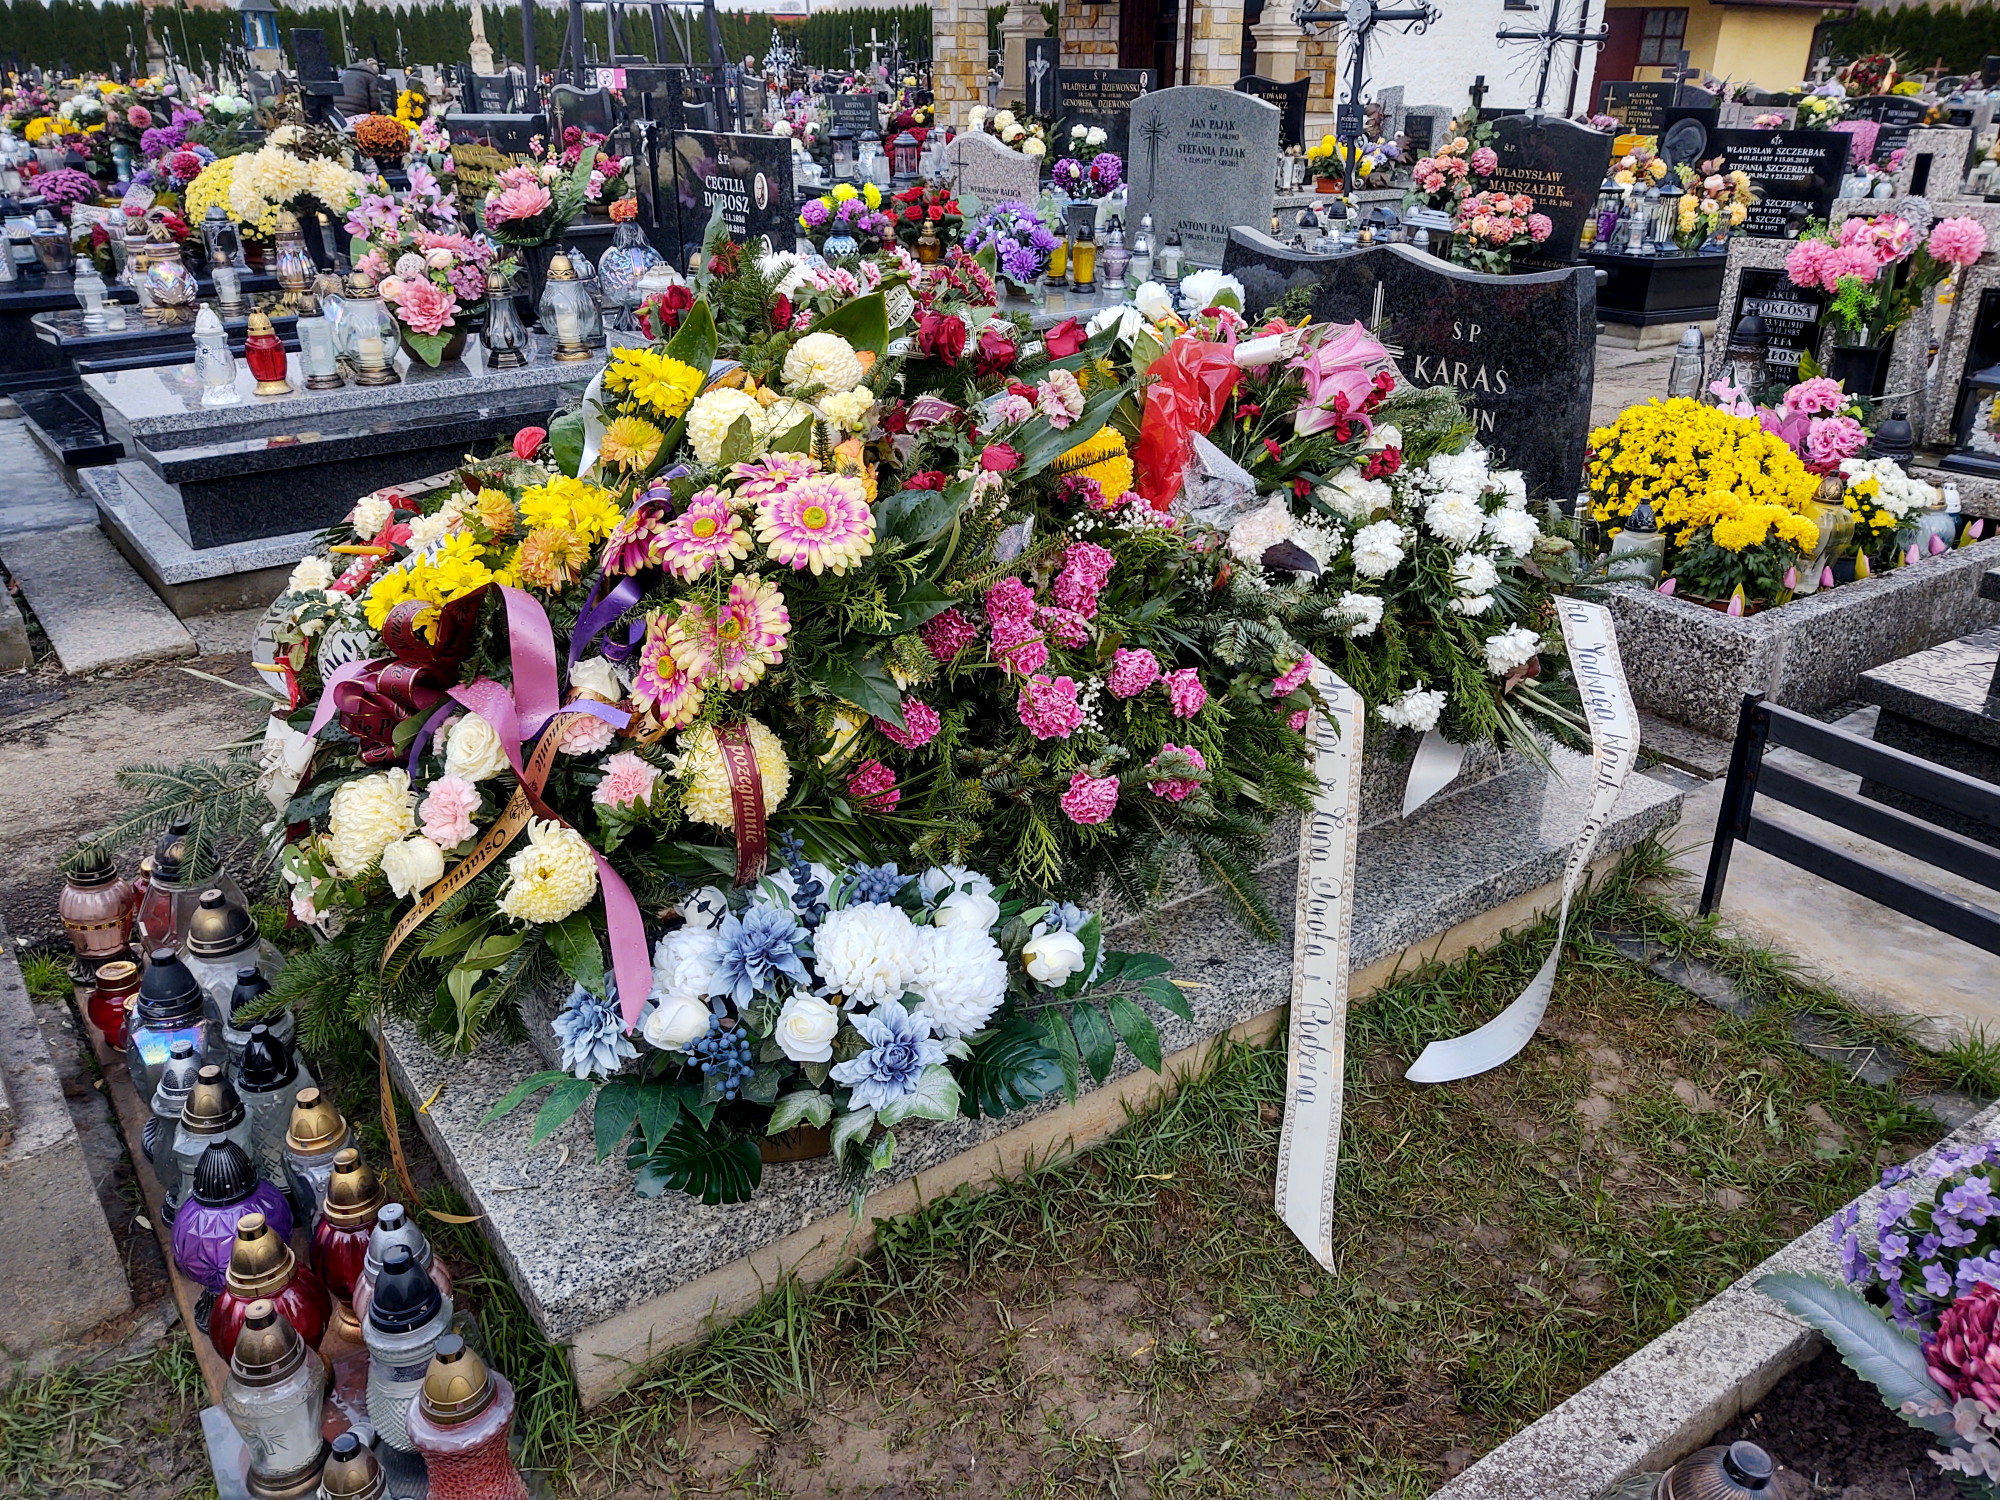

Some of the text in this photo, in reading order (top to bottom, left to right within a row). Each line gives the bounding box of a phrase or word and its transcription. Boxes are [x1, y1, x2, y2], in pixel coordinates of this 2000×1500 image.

[1062, 82, 1096, 91] WŁADYSŁAW
[1062, 98, 1093, 108] GENOWEFA
[1190, 119, 1236, 132] JAN PAJĄK
[1177, 143, 1246, 159] STEFANIA PAJĄK
[1726, 146, 1825, 157] WŁADYSŁAW SZCZERBAK
[1495, 167, 1562, 182] WŁADYSŁAW
[1729, 163, 1815, 174] STEFANIA SZCZERBAK
[705, 175, 745, 193] CECYLIA
[1488, 179, 1565, 197] MARSZAŁEK
[1177, 220, 1207, 234] ANTONI
[1765, 289, 1798, 301] JAKUB
[1414, 354, 1509, 395] KARAŚ
[441, 828, 506, 895] Ostatnie
